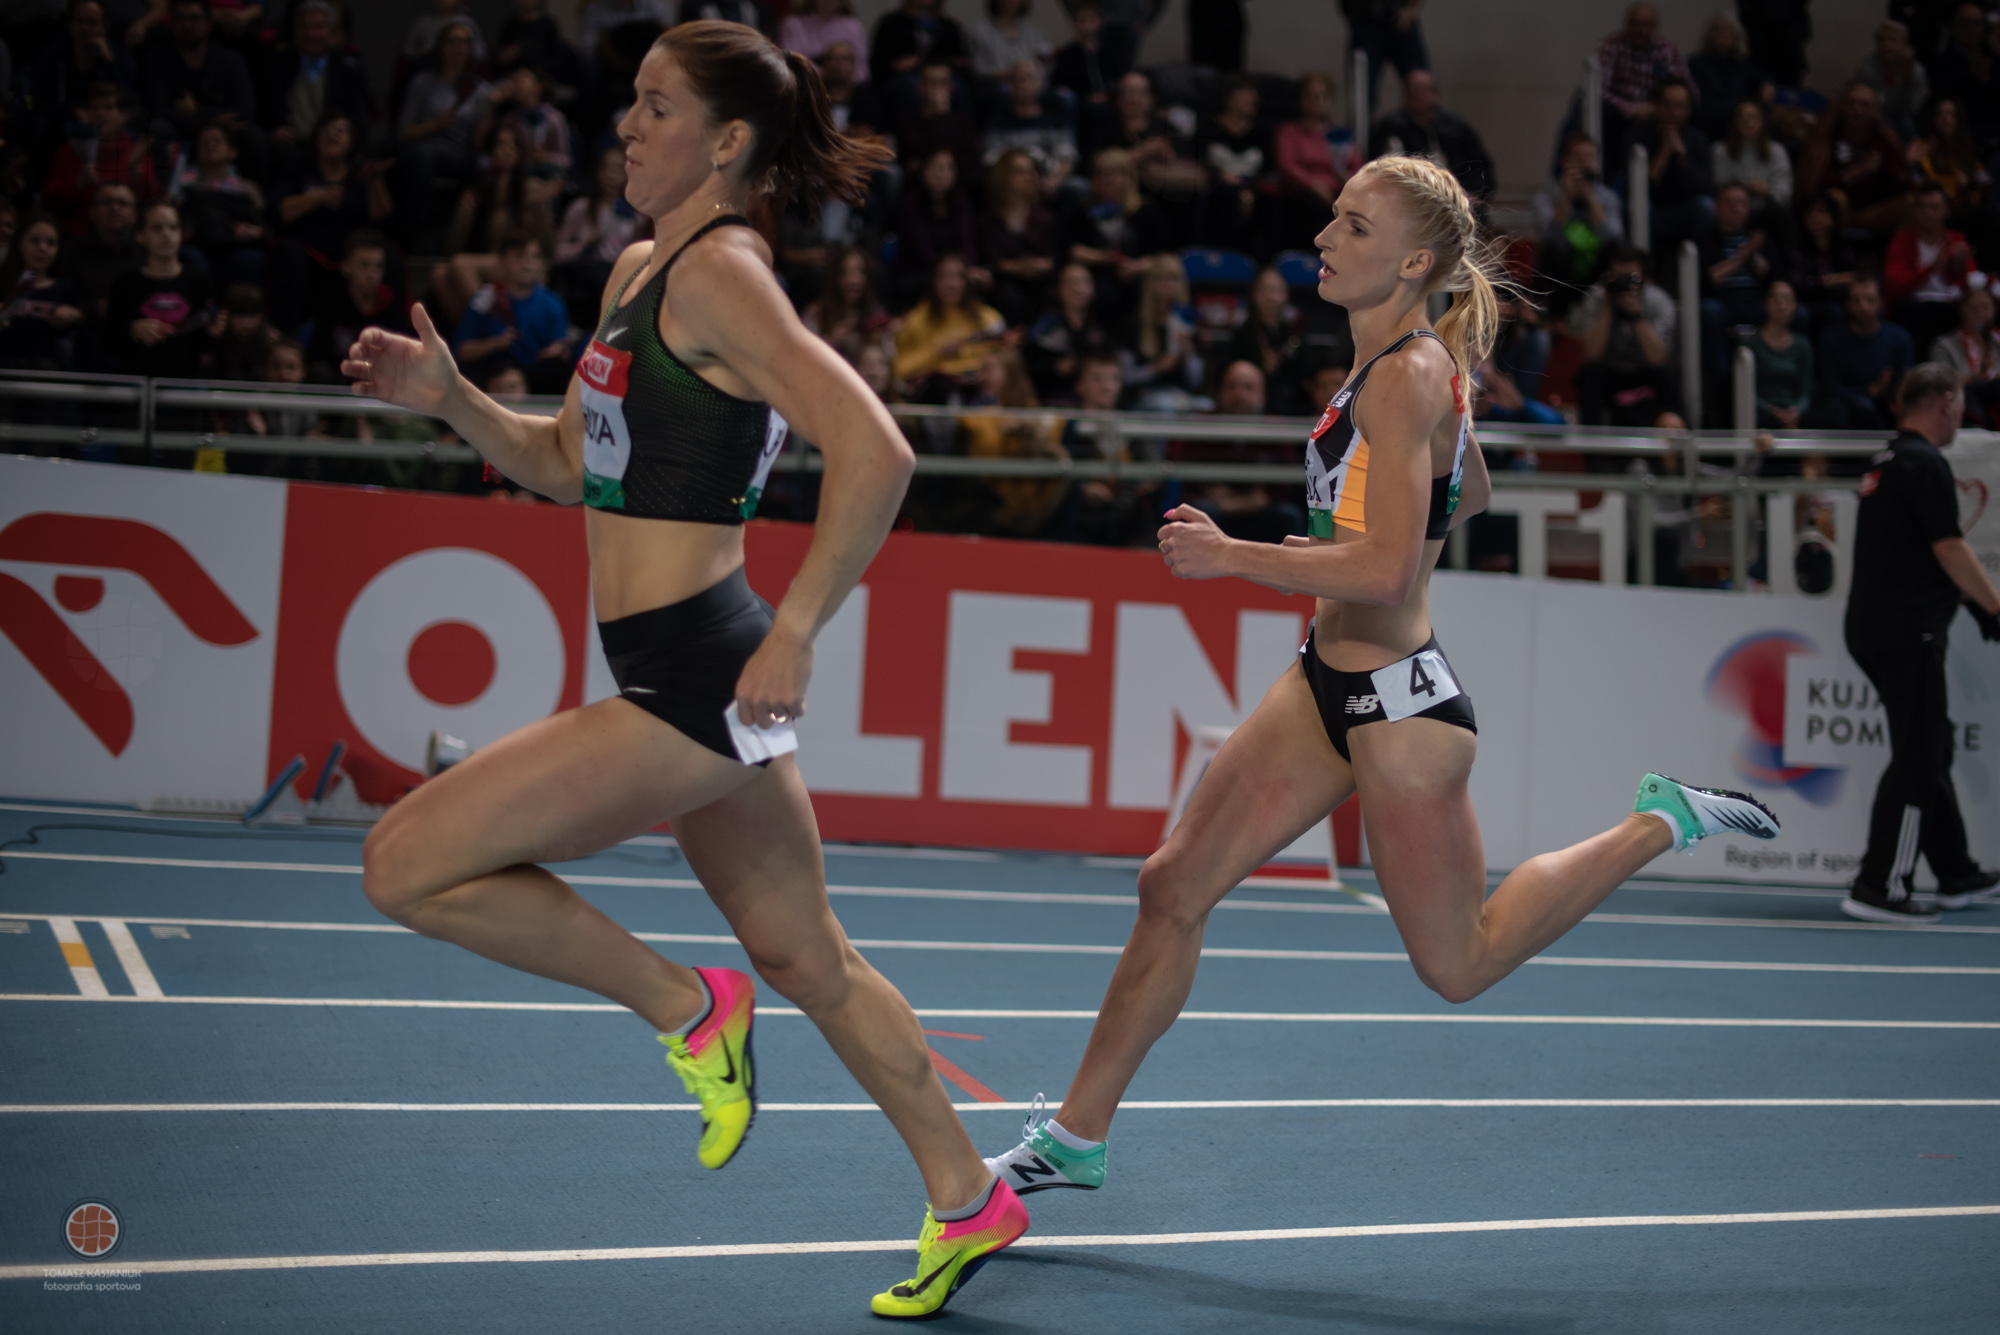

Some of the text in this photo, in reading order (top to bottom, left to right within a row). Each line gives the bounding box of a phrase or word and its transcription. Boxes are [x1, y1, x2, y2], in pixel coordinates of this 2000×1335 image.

[335, 545, 1304, 811] OLEN
[1409, 656, 1437, 698] 4
[1725, 844, 1792, 872] Region
[1797, 848, 1818, 870] of
[1009, 1154, 1056, 1183] N
